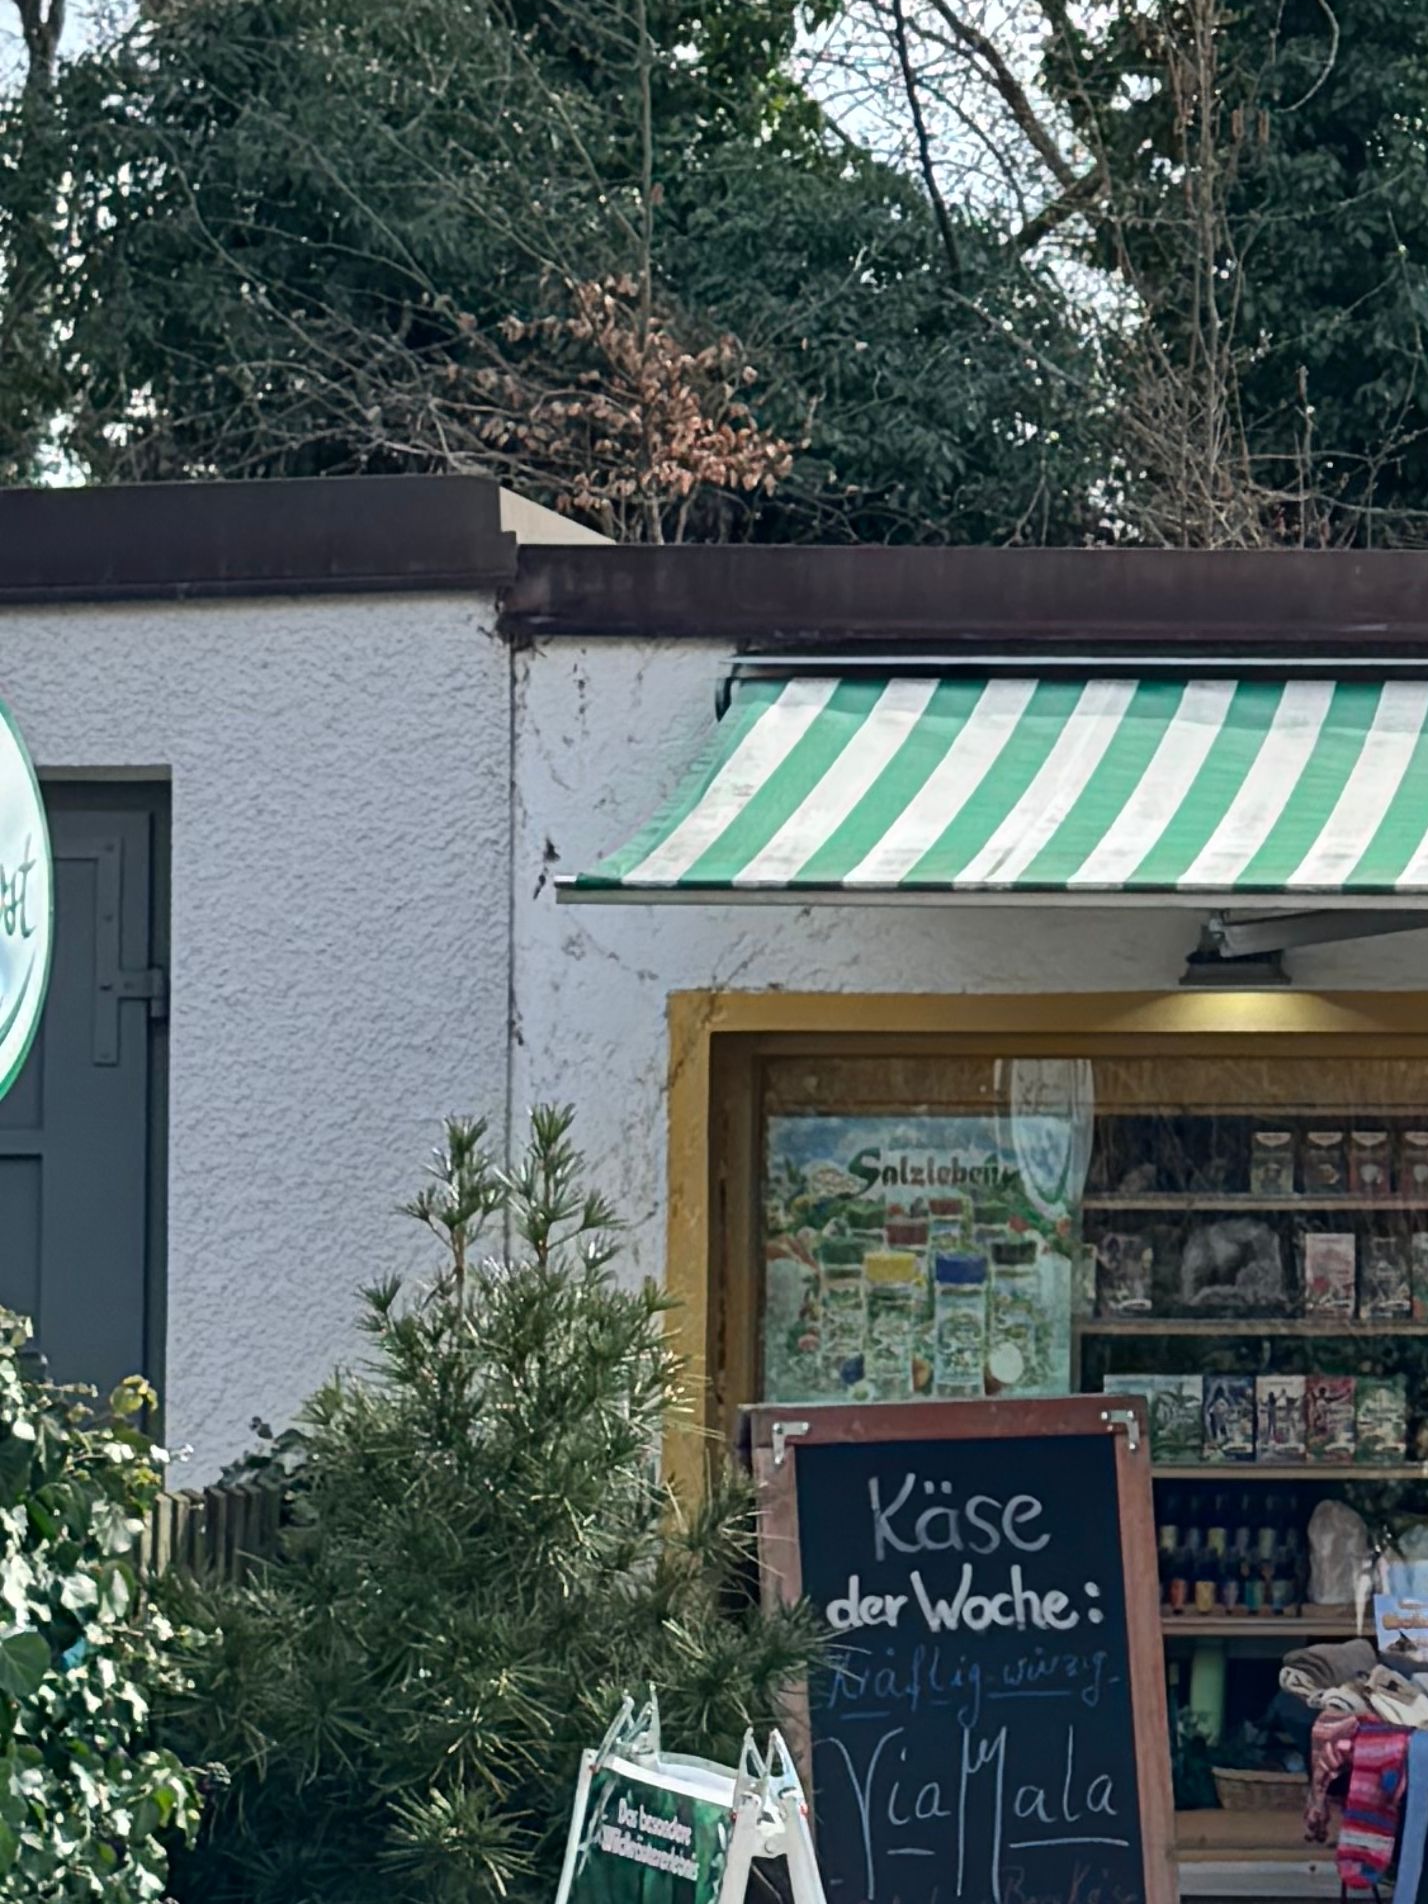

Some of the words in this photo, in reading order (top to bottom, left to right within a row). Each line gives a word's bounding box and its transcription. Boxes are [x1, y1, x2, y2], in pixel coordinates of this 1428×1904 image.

[868, 1472, 1051, 1561] Käse
[825, 1574, 908, 1630] der
[910, 1562, 1104, 1633] Woche:
